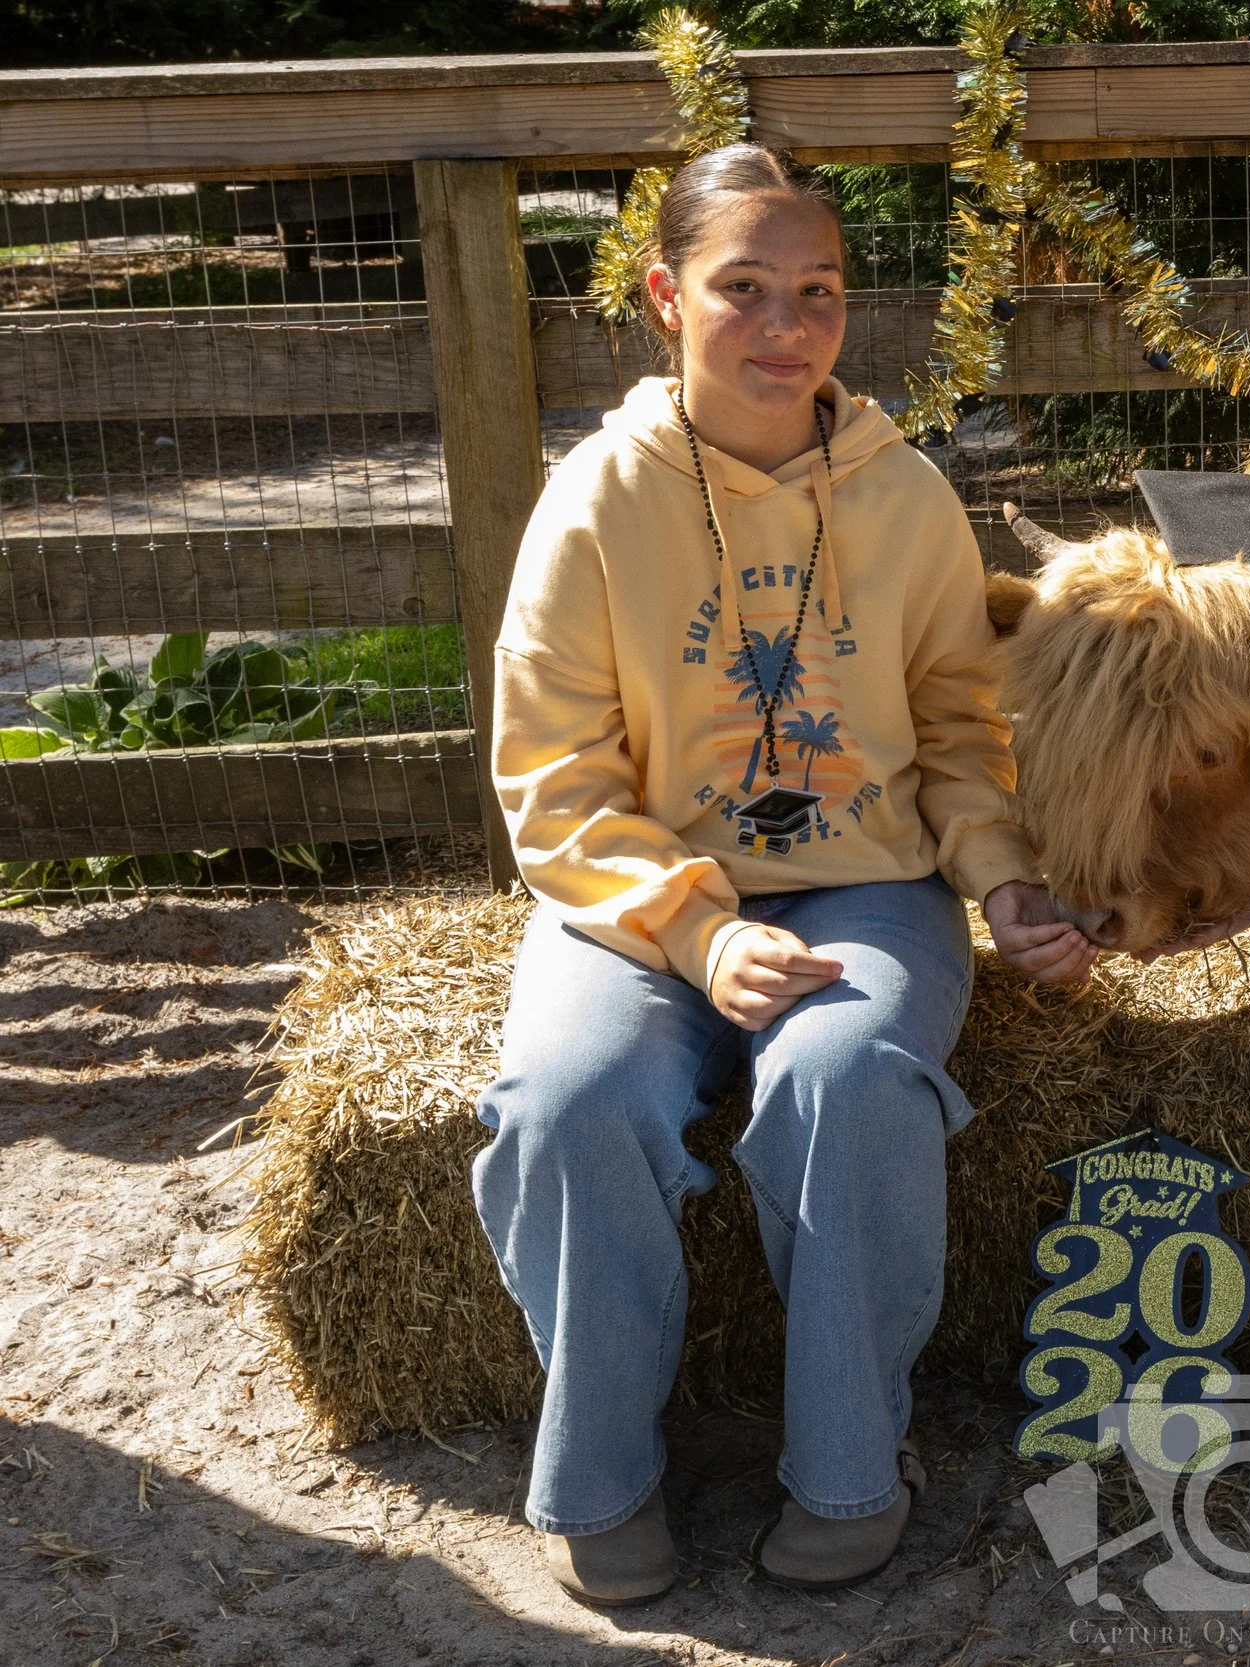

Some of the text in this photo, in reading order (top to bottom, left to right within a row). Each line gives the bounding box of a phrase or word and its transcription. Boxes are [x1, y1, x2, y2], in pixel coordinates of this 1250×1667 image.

[1083, 1151, 1214, 1192] CONGRATS
[1098, 1184, 1202, 1227] Grad!
[1029, 1224, 1245, 1349] 20
[1018, 1346, 1232, 1473] 26
